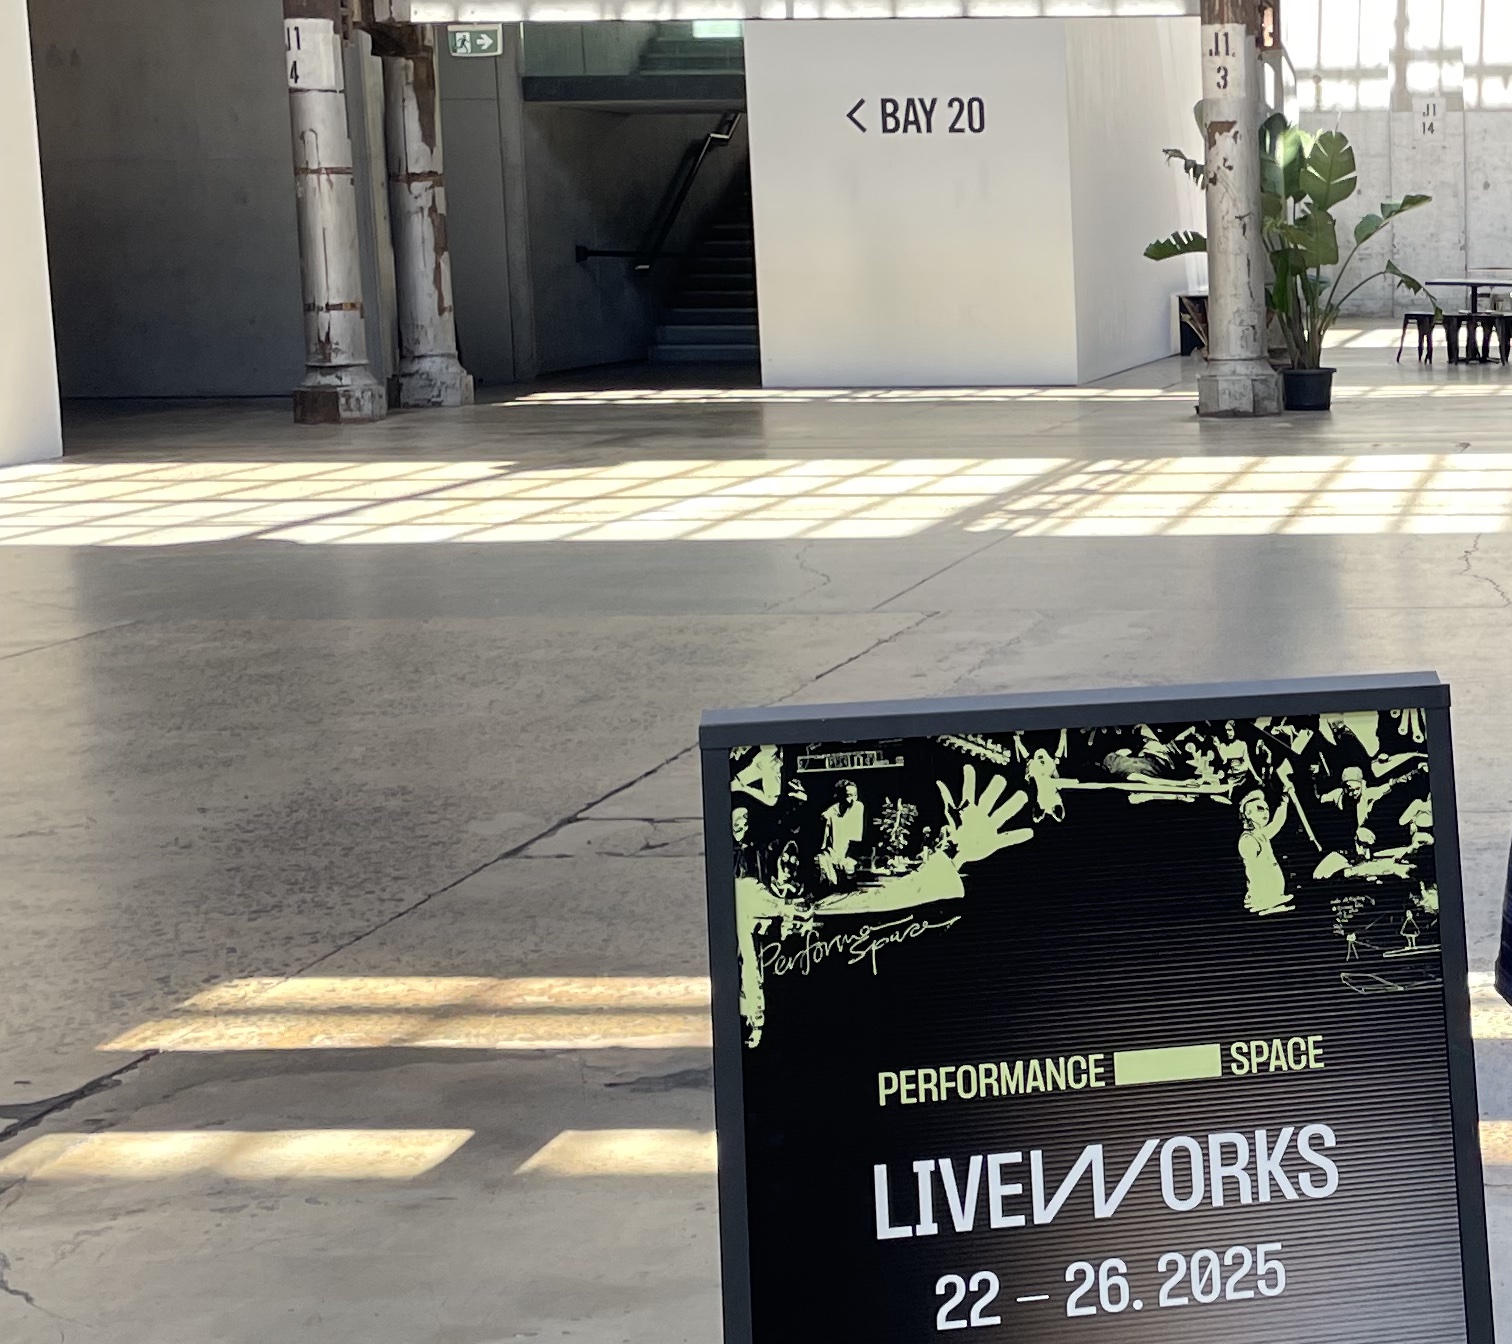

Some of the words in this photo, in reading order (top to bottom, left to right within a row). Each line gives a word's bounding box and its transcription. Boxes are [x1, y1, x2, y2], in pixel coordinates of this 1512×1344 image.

[290, 60, 300, 84] 4
[1216, 66, 1228, 89] 3
[880, 97, 938, 133] BAY
[947, 97, 985, 133] 20
[878, 1053, 1106, 1106] PERFORMANCE
[1230, 1035, 1325, 1076] SPACE
[874, 1123, 1339, 1240] LIVEWORKS
[934, 1270, 1002, 1331] 22
[1064, 1257, 1145, 1318] 26.
[1157, 1242, 1287, 1308] 2025
